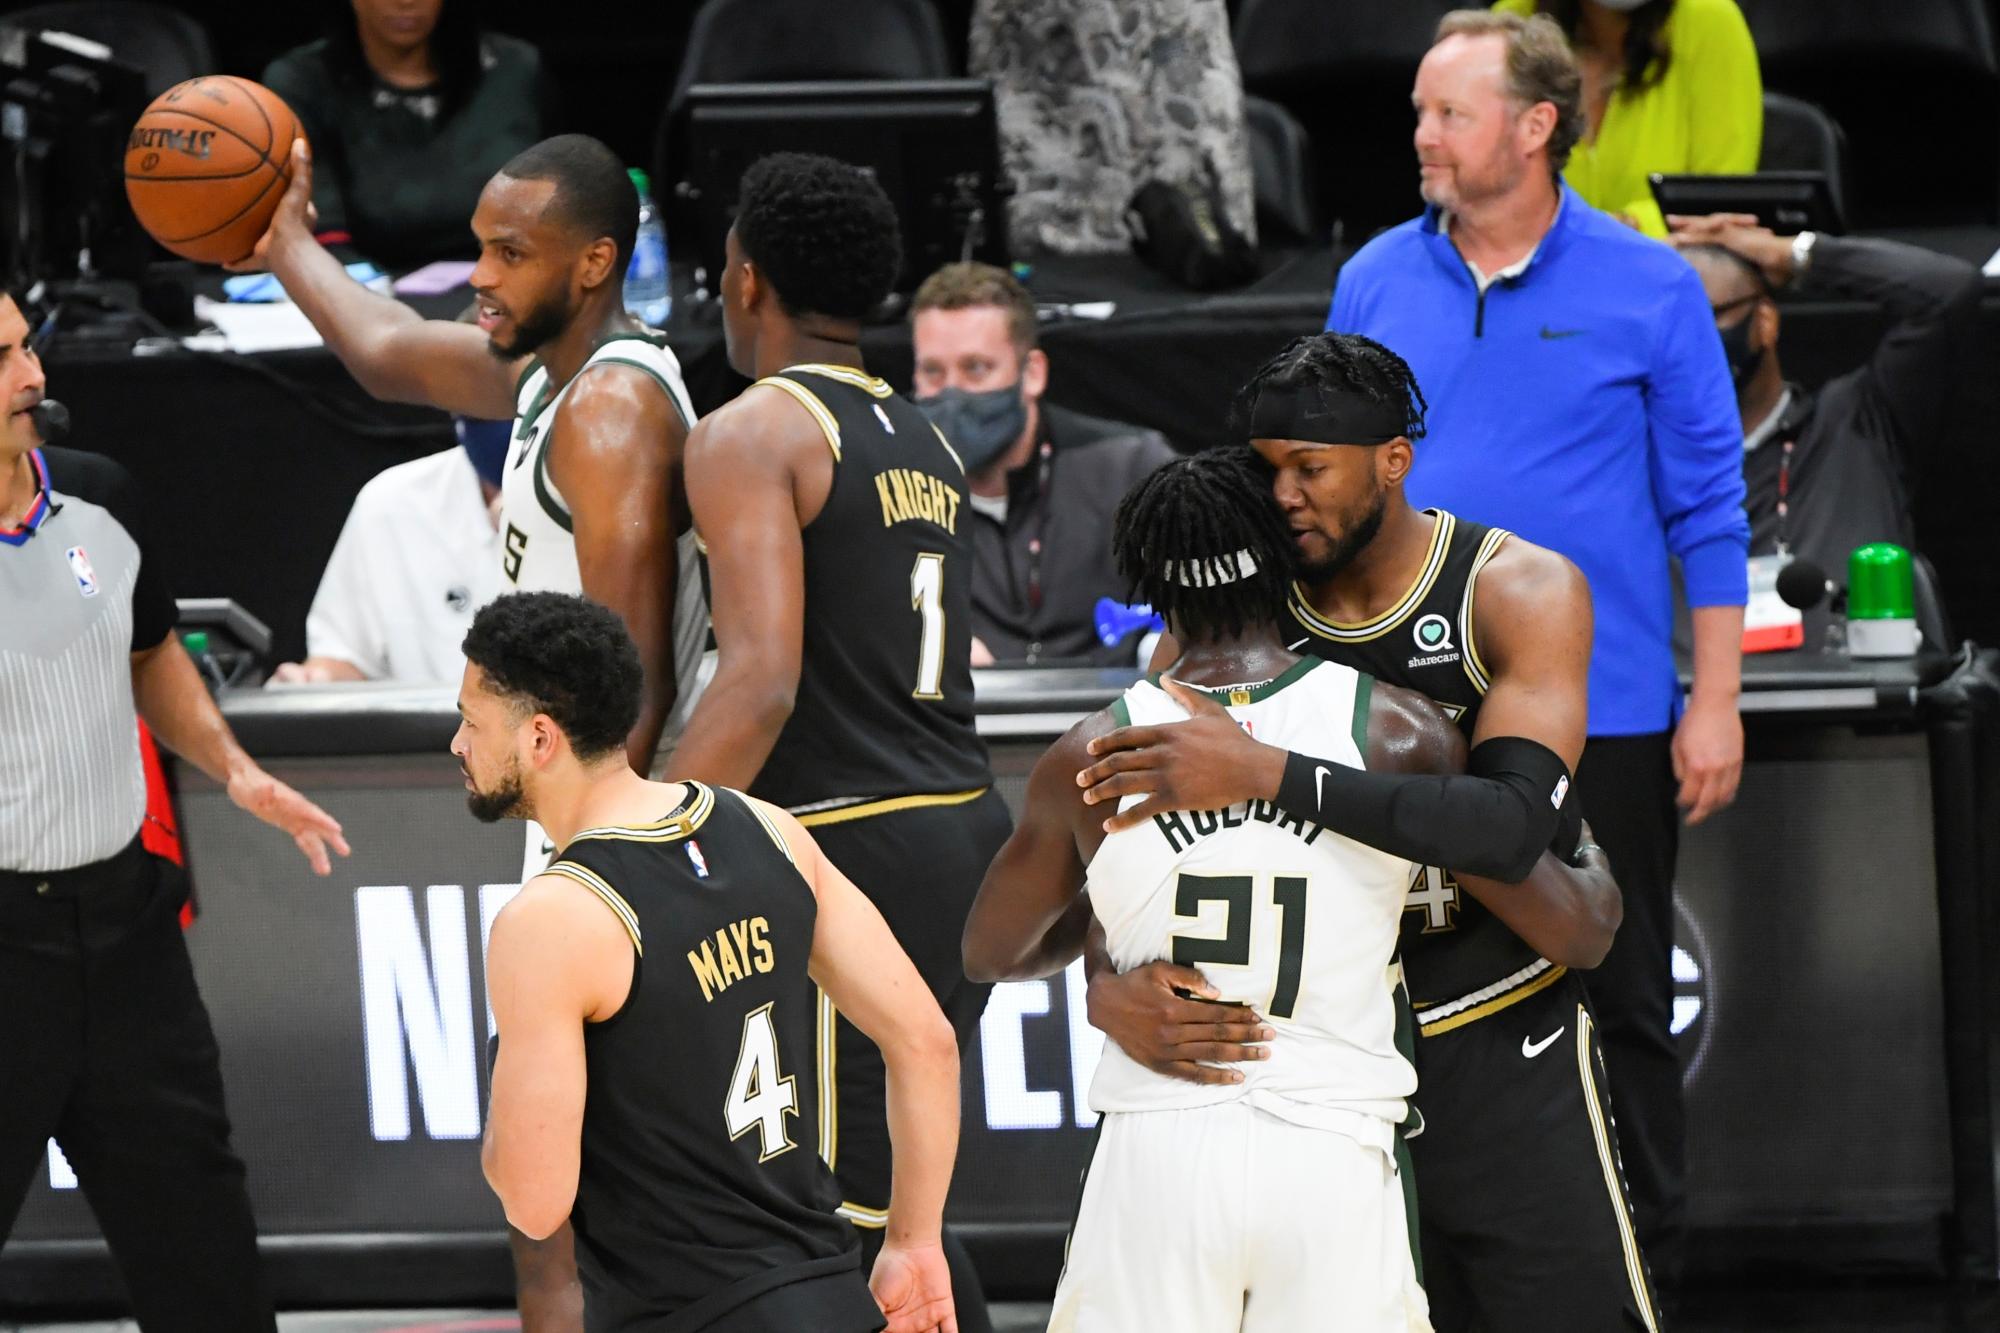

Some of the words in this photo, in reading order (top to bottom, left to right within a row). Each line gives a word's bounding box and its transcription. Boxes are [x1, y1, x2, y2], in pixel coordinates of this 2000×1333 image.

[874, 468, 961, 535] KNIGHT
[910, 552, 946, 700] 1
[1407, 652, 1460, 668] sharecare
[687, 916, 775, 1003] MAYS
[1169, 870, 1312, 1024] 21
[724, 1001, 799, 1164] 4
